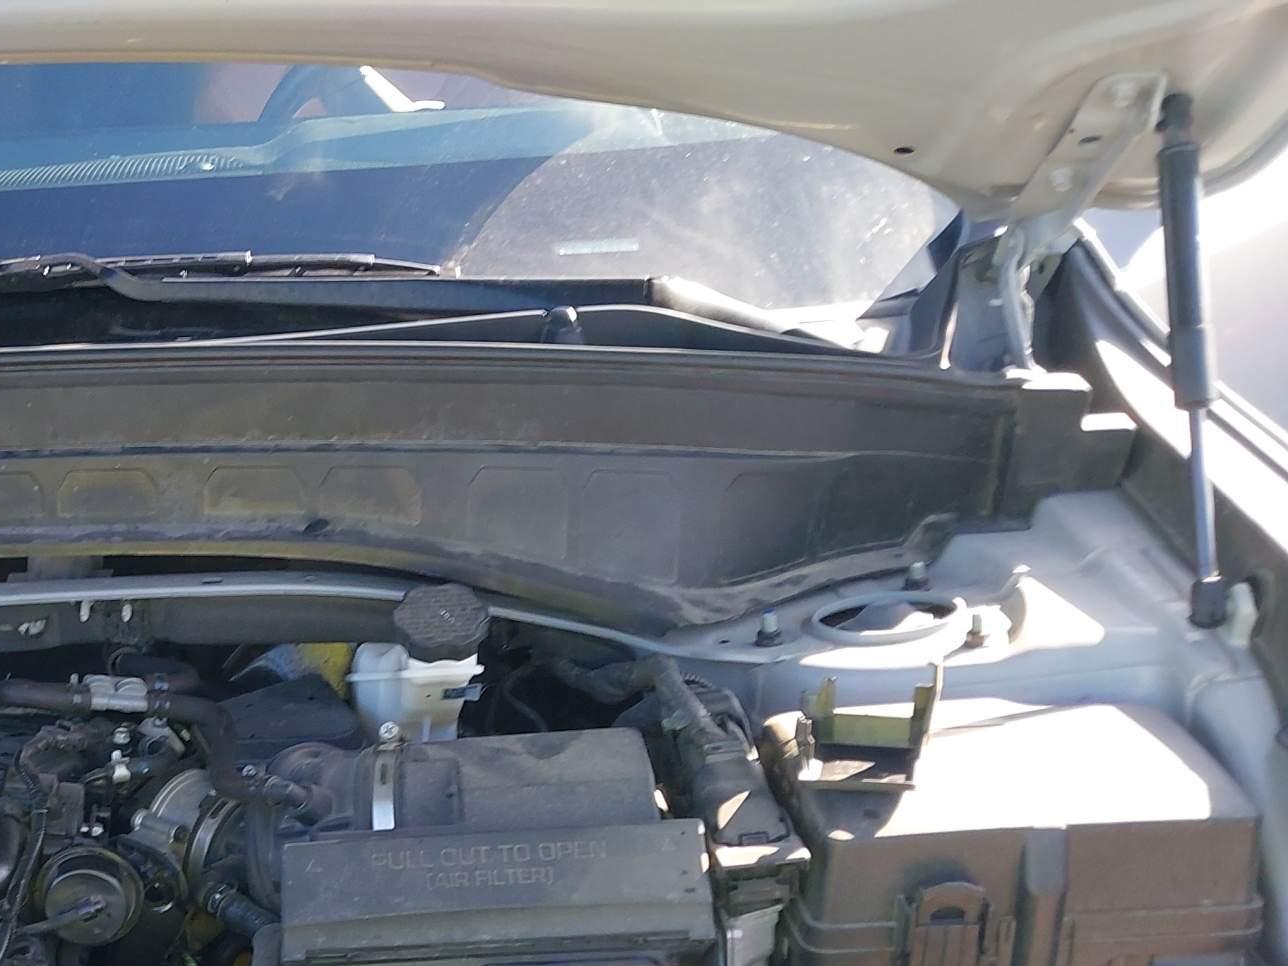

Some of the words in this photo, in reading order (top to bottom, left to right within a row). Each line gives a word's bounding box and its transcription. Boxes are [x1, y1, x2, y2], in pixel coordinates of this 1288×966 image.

[371, 851, 433, 870] PULL
[440, 847, 490, 866] OUT
[497, 843, 531, 863] TO
[538, 840, 608, 861] OPEN
[426, 872, 470, 890] (AIR
[474, 866, 554, 888] FILTER)
